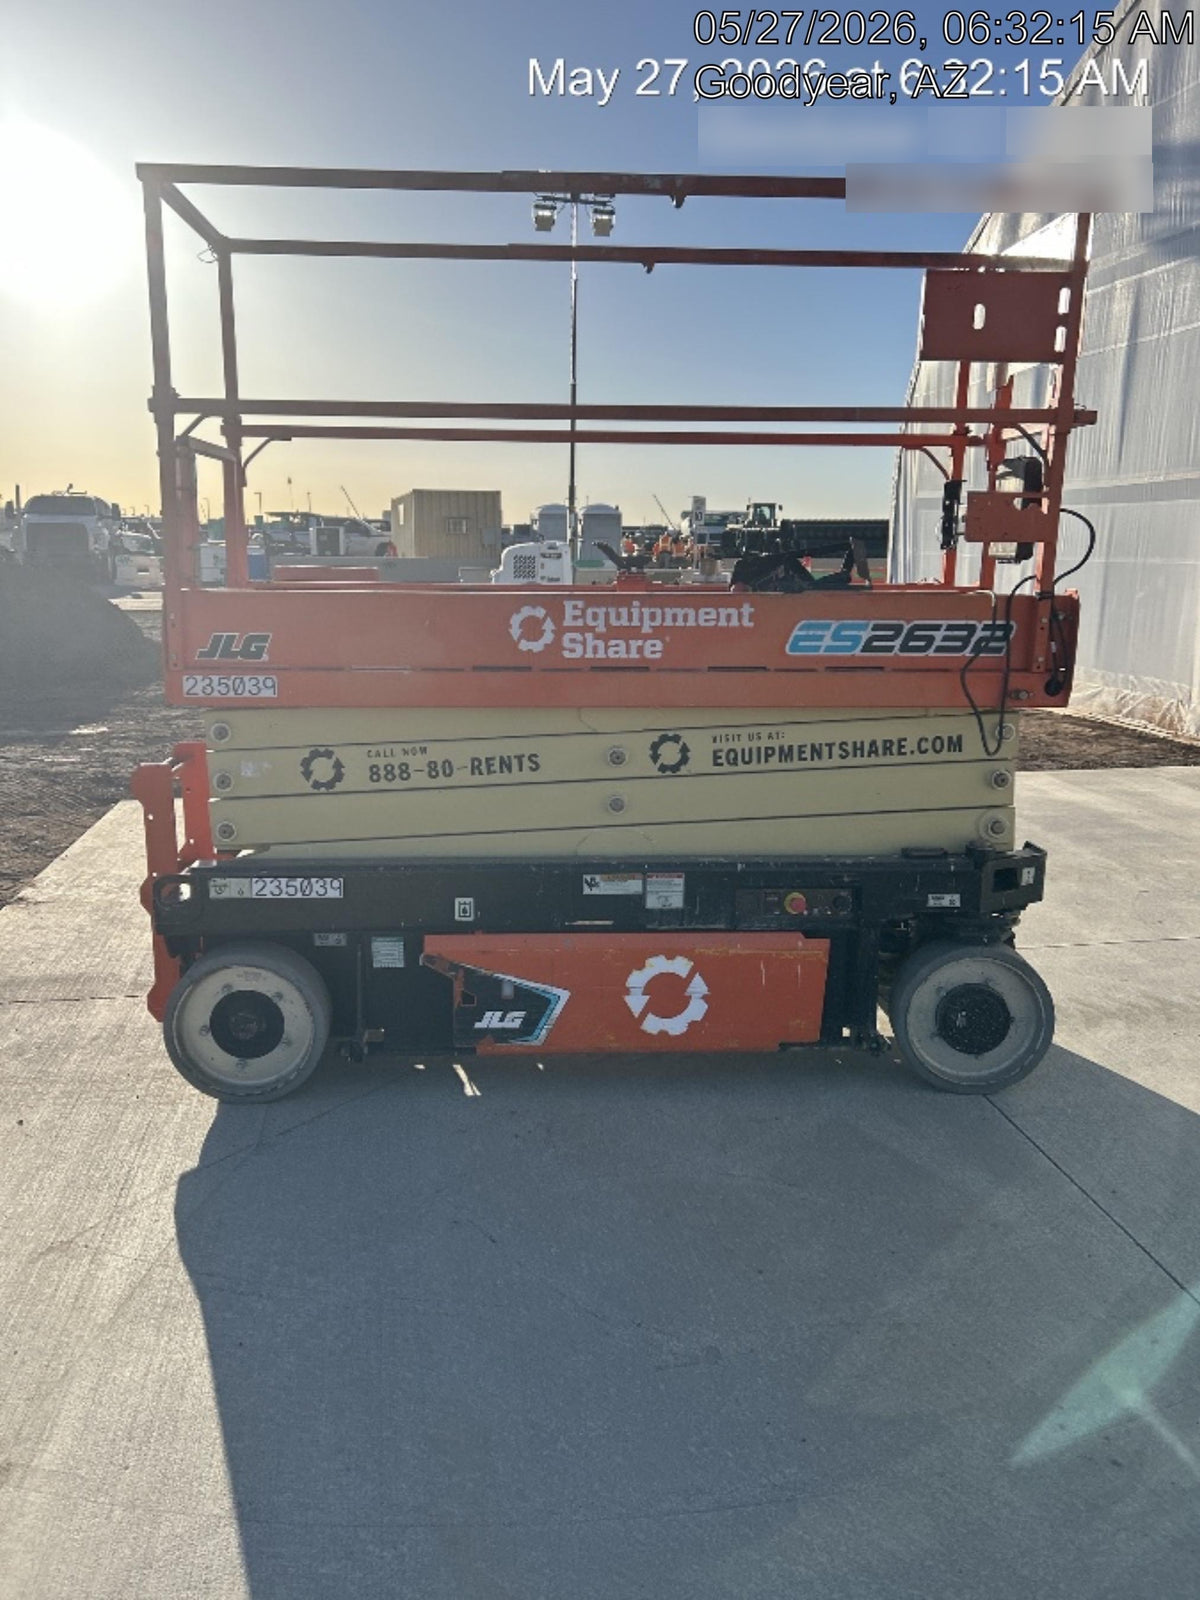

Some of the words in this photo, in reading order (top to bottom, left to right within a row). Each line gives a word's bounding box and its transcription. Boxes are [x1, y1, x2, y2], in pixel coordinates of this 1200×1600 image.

[563, 600, 755, 633] Equipment
[195, 632, 272, 661] JLG
[562, 632, 664, 659] Share
[785, 619, 1017, 656] ES2632
[185, 676, 277, 696] 235039
[711, 733, 742, 744] VISIT
[748, 731, 762, 742] US
[767, 731, 786, 741] AT:
[711, 734, 964, 768] EQUIPMENTSHARE.COM
[367, 749, 397, 759] CALL
[402, 746, 428, 757] NOW
[368, 753, 541, 783] 888-80-RENTS
[254, 879, 342, 897] 235039
[473, 1010, 527, 1029] JLG
